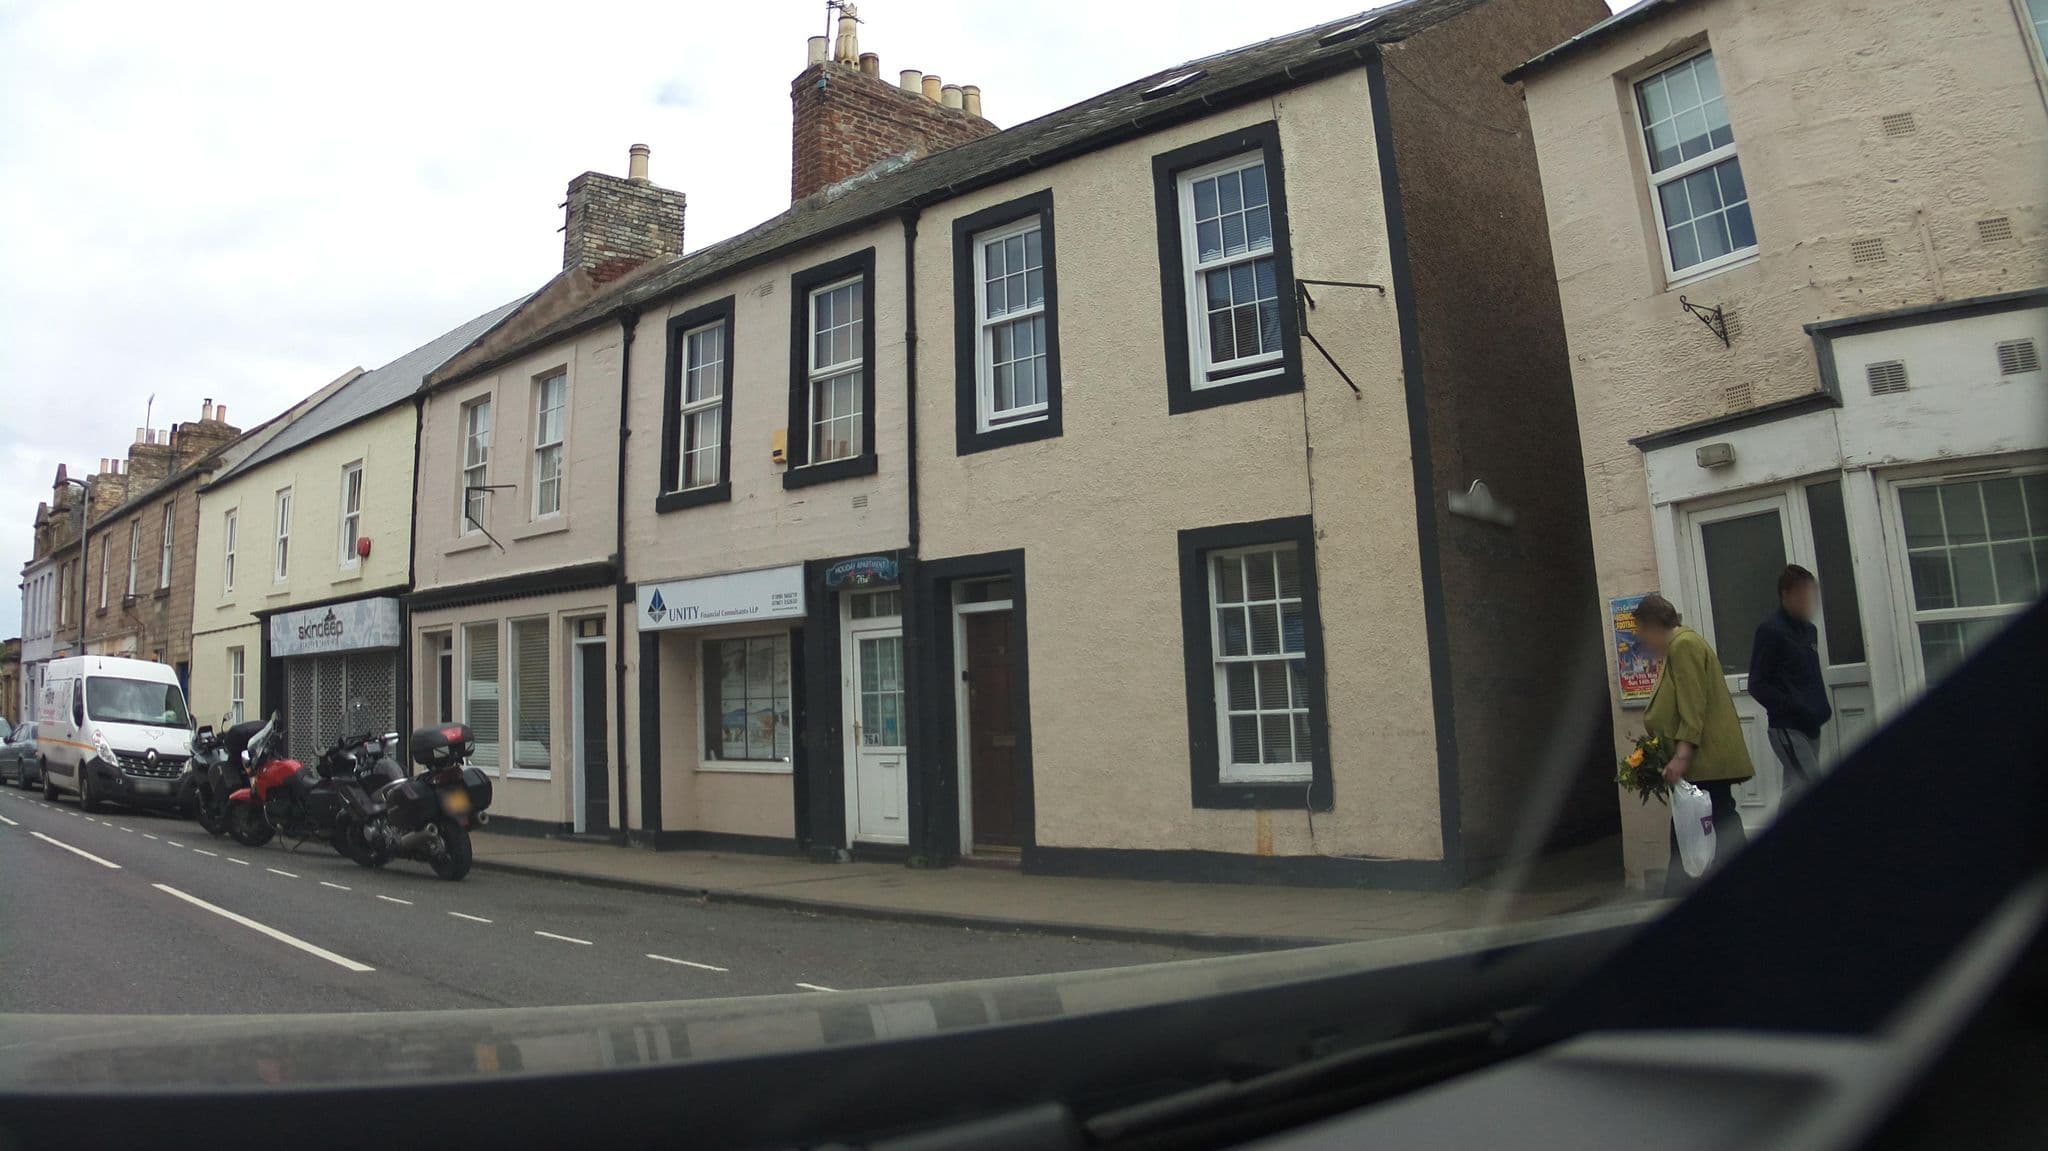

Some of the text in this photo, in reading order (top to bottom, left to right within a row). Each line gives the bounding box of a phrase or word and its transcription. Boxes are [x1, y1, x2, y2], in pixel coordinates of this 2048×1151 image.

[668, 606, 700, 622] UNITY
[700, 610, 721, 619] Financial
[298, 615, 344, 646] skindeep
